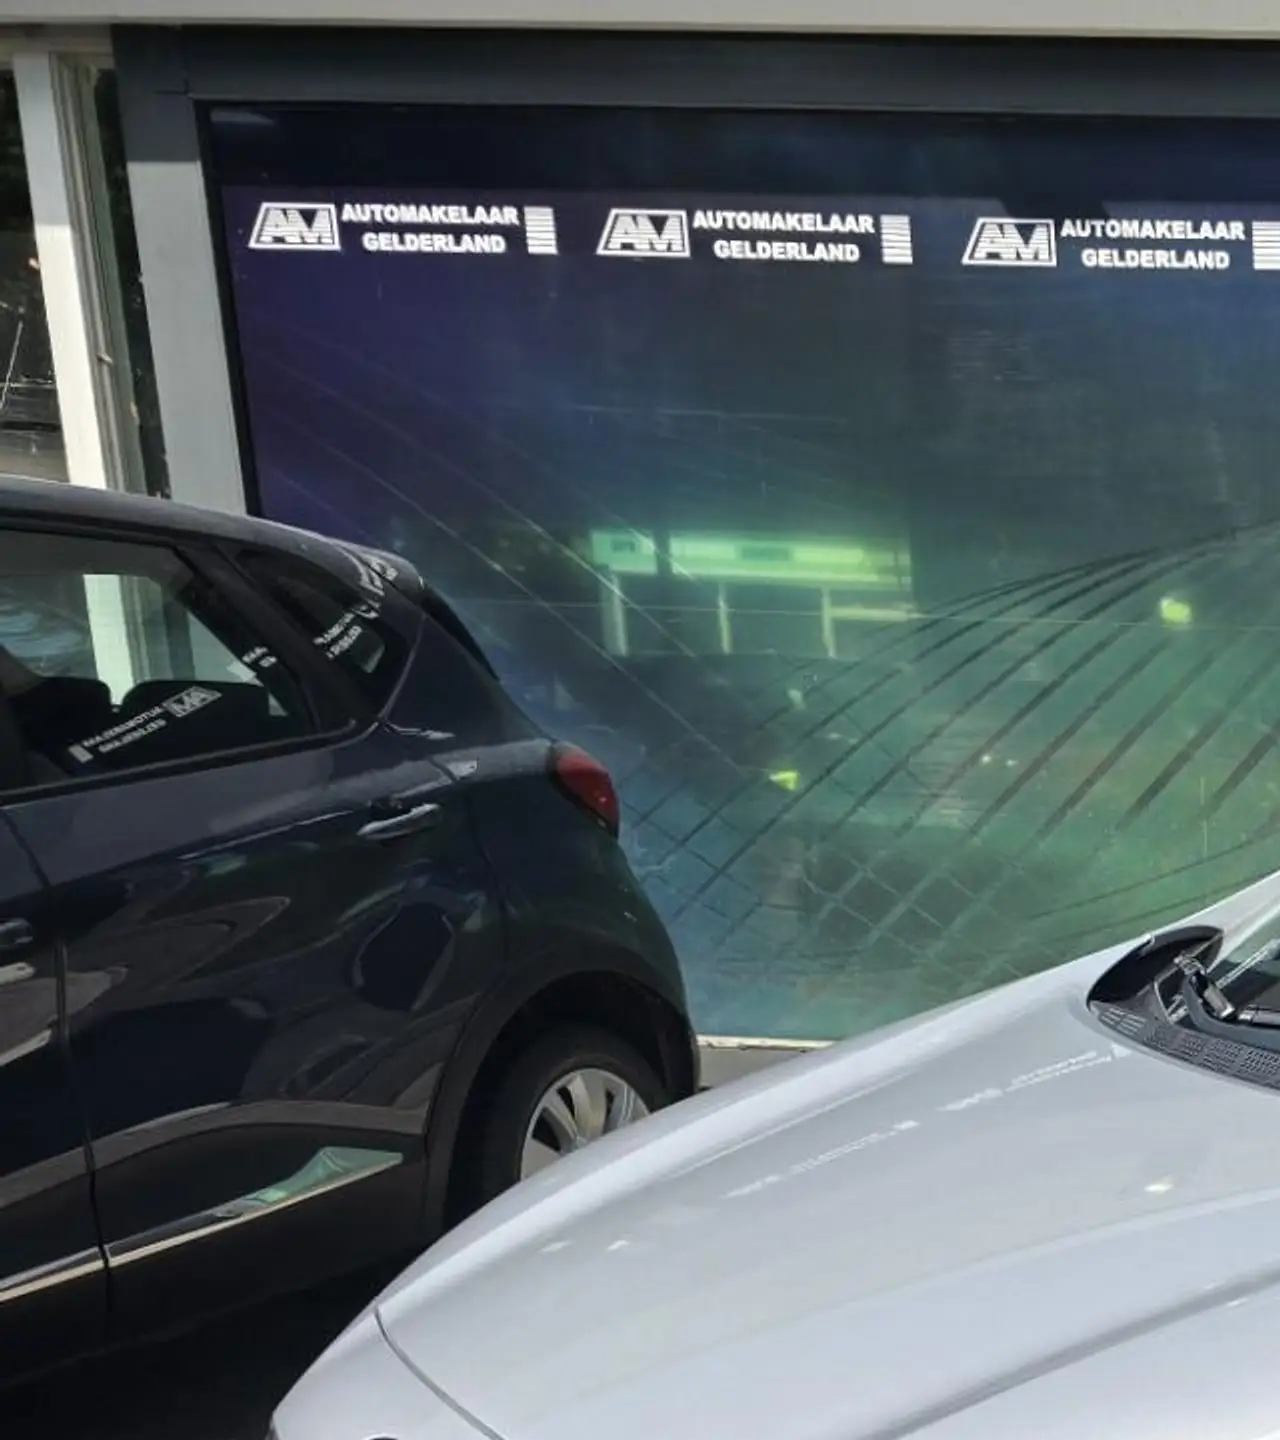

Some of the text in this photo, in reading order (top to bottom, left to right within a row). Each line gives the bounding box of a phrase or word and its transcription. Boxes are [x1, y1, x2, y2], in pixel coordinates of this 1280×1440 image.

[255, 205, 336, 246] AM
[340, 203, 520, 226] AUTOMAKELAAR
[692, 209, 876, 234] AUTOMAKELAAR
[604, 213, 685, 252] AM
[971, 222, 1050, 261] AM
[1059, 218, 1247, 241] AUTOMAKELAAR
[361, 231, 507, 254] GELDERLAND
[713, 239, 861, 263] GELDERLAND
[1080, 247, 1231, 270] GELDERLAND
